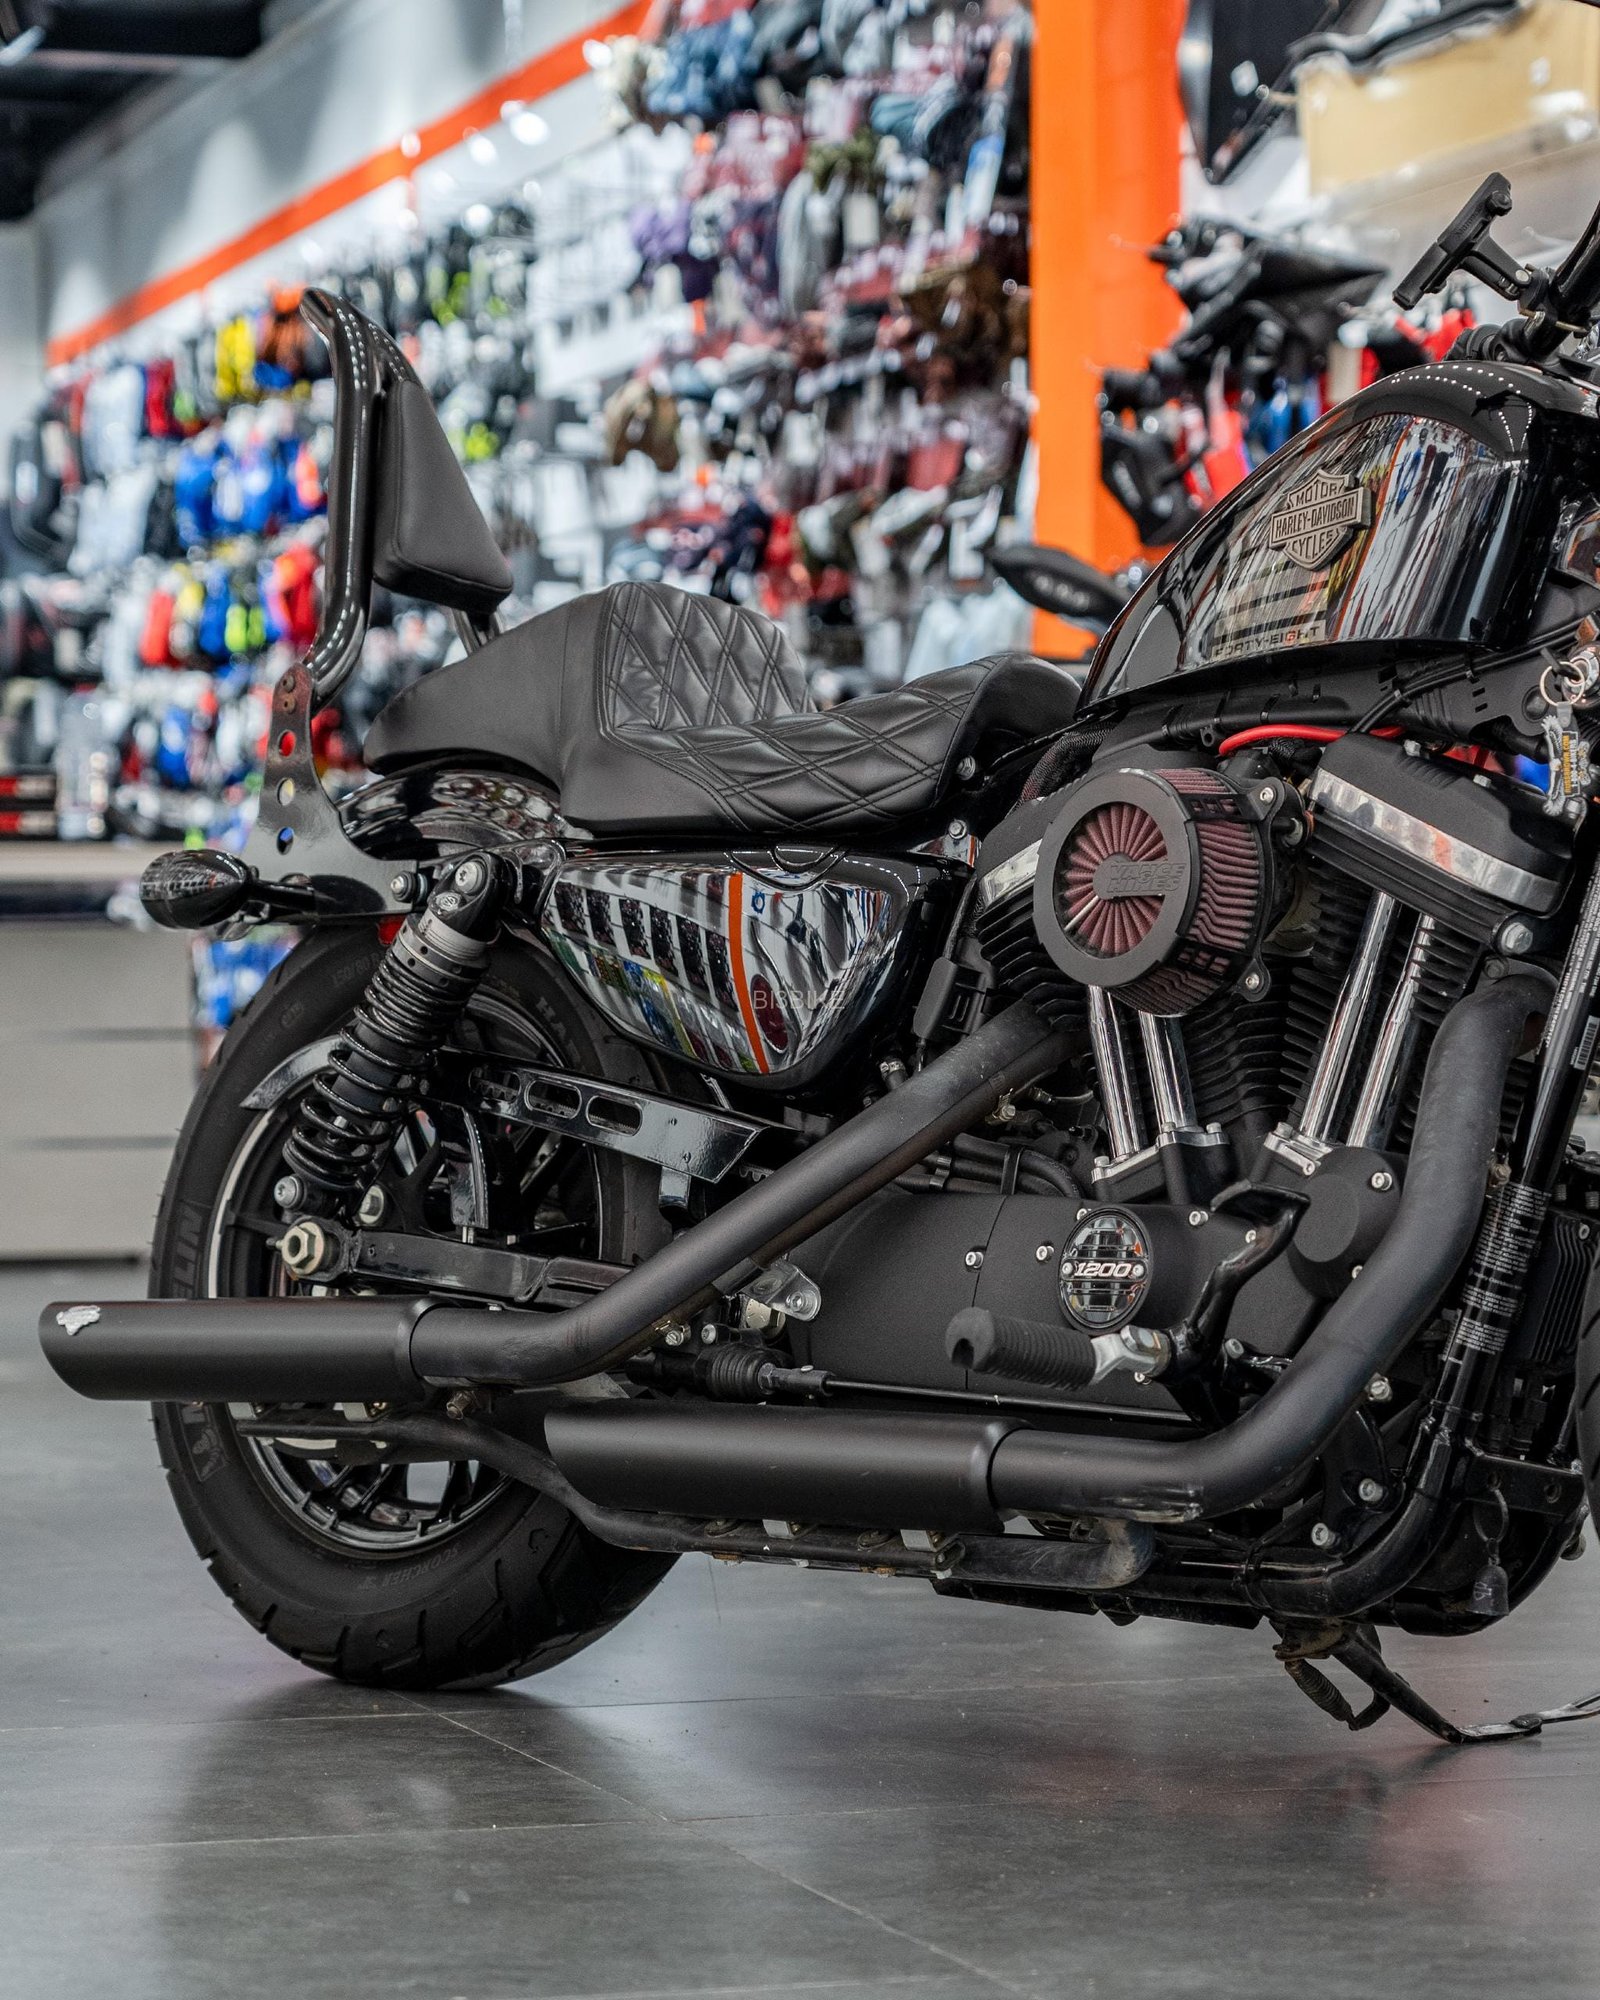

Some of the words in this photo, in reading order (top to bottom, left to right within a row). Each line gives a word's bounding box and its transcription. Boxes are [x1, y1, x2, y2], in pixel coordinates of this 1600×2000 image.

[1295, 481, 1340, 507] MOTOR
[1275, 496, 1355, 539] HARLEY-DAVIDSON
[1291, 530, 1335, 560] CYCLES
[1214, 625, 1321, 658] FORTY-EIGHT
[1110, 863, 1187, 879] VANCE
[1106, 876, 1183, 894] HINES
[1074, 1262, 1132, 1277] 1200
